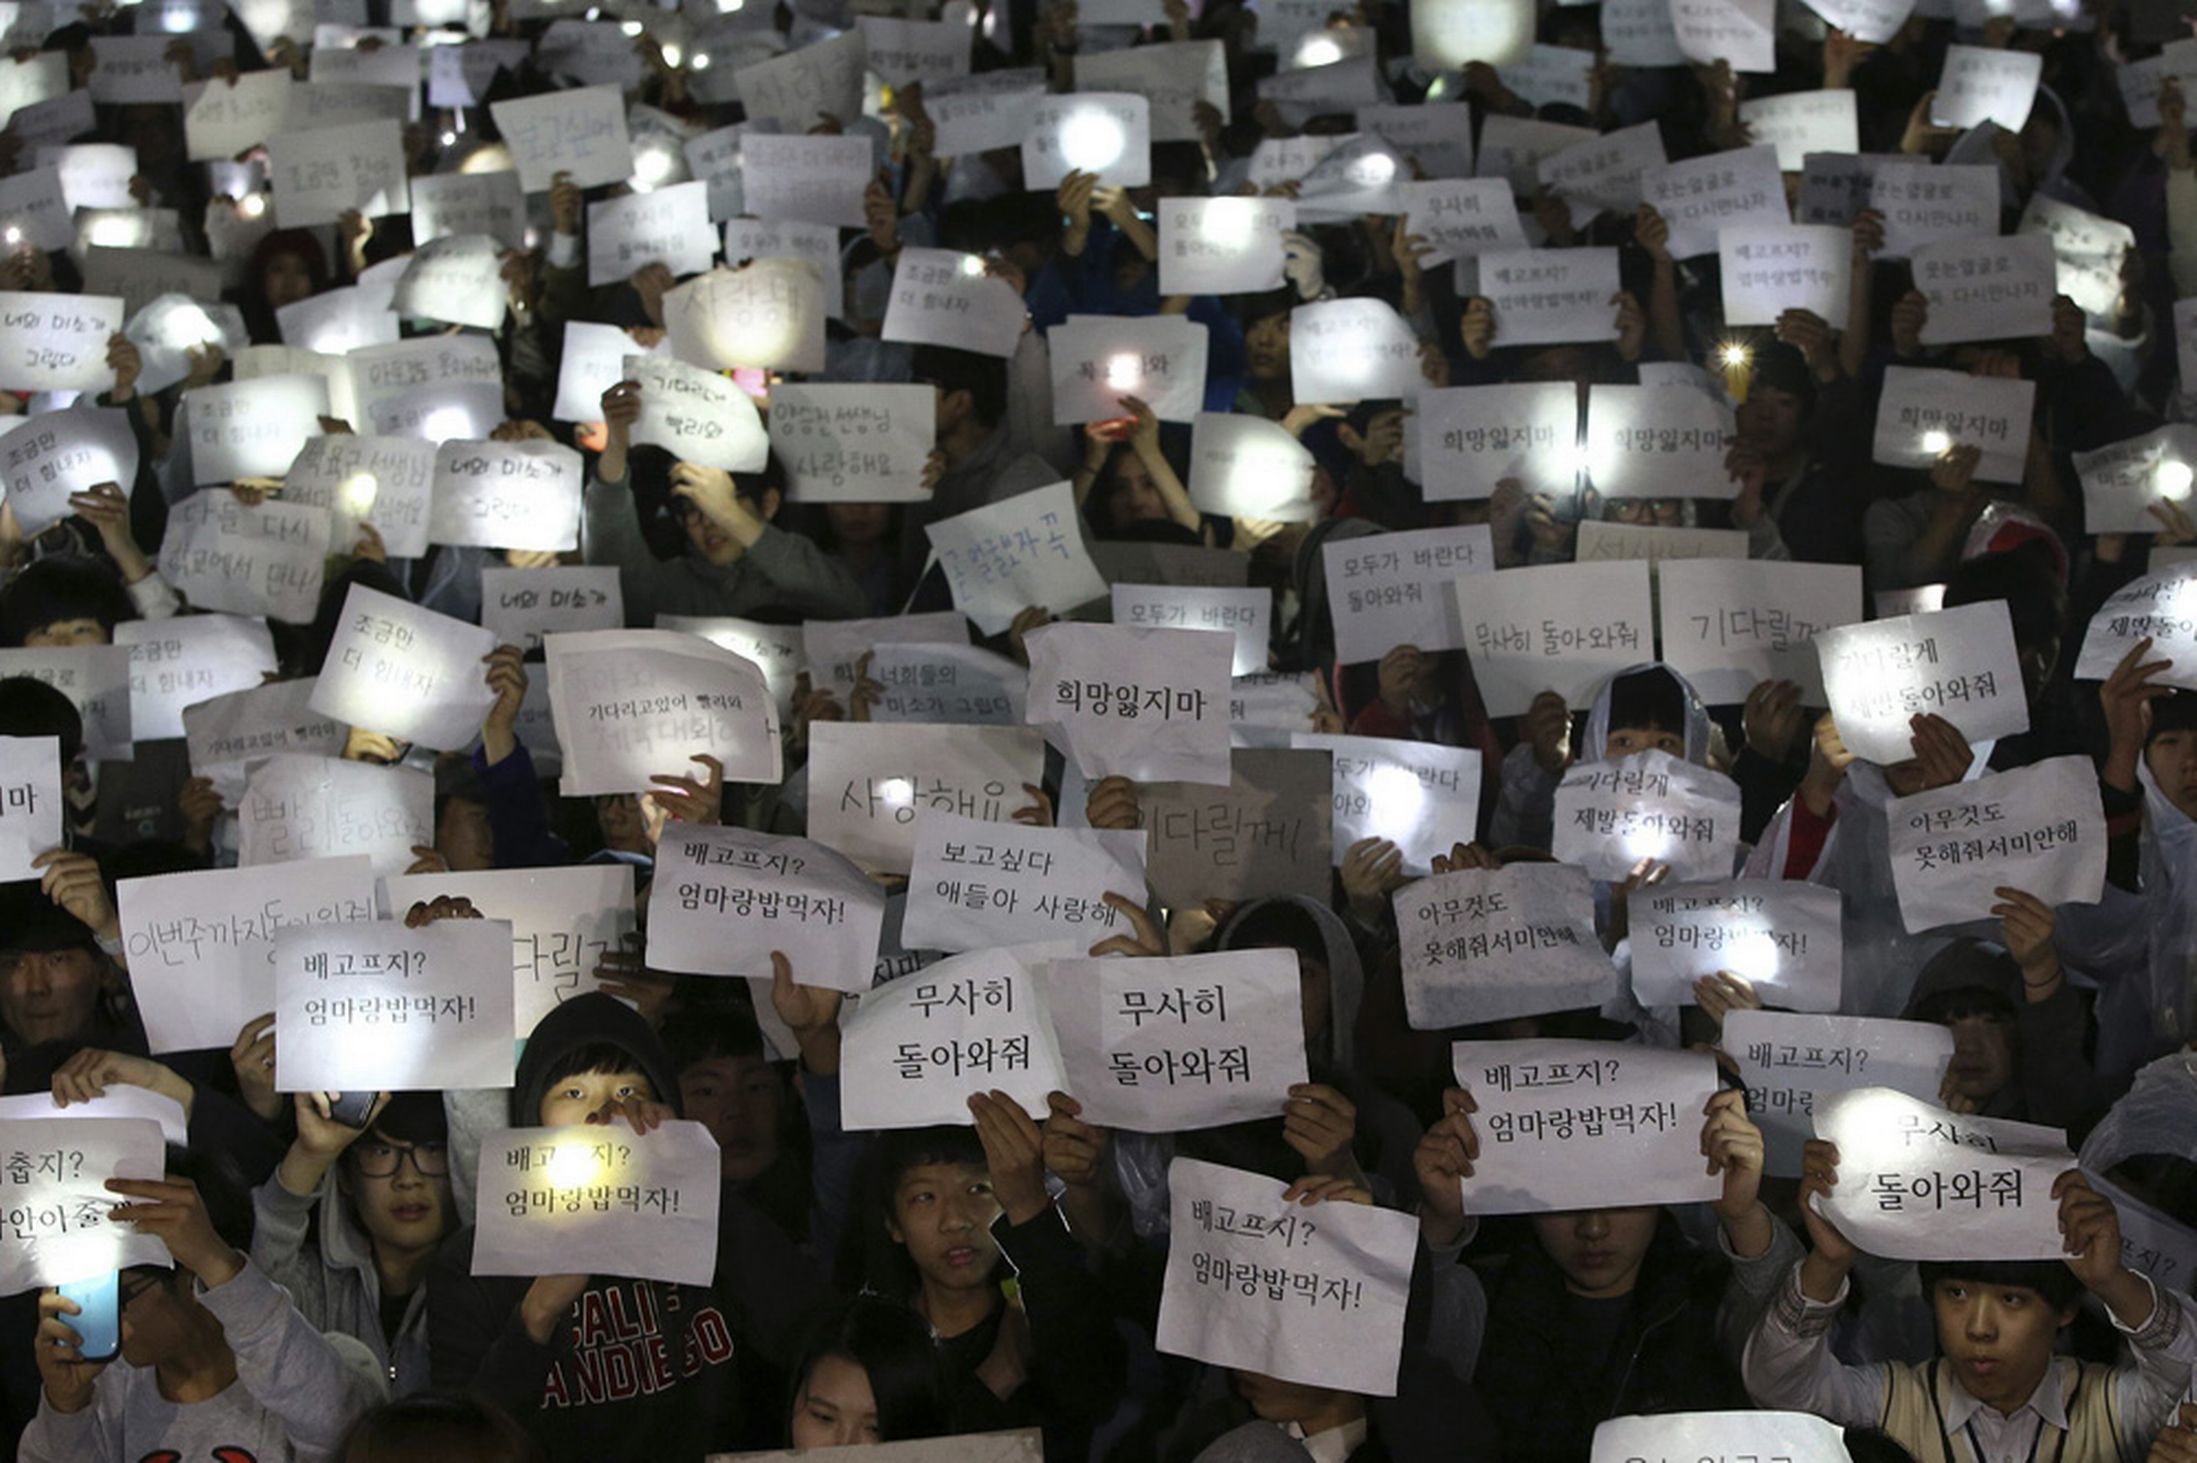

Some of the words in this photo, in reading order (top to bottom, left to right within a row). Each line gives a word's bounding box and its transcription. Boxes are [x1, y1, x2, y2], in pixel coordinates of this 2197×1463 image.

[1055, 679, 1208, 721] 희망잃지마
[0, 783, 38, 816] 마
[1909, 801, 2007, 834] 아무것도
[684, 840, 806, 877] 배고프지?
[941, 841, 1055, 877] 보고싶다
[1914, 818, 2080, 872] 못해줘서미안해
[678, 882, 846, 925] 엄마랑밥먹자!
[936, 878, 1019, 914] 애들아
[1033, 894, 1118, 928] 사랑해
[1417, 892, 1509, 928] 아무것도
[1654, 924, 1809, 957] 엄마랑자!
[303, 950, 427, 980] 배고프지?
[303, 995, 477, 1026] 엄마랑밥먹자!
[909, 976, 1014, 1019] 무사히
[1118, 984, 1228, 1027] 무사히
[893, 1034, 1031, 1079] 돌아와줘
[1107, 1044, 1252, 1087] 돌아와줘
[1483, 1059, 1620, 1092] 배고프지?
[1748, 1042, 1870, 1074] 배고프지?
[1488, 1101, 1679, 1144] 엄마랑밥먹자!
[0, 1150, 85, 1188] 춥지?
[505, 1141, 632, 1173] 배고지?
[505, 1185, 680, 1216] 엄마랑밥먹자!
[1870, 1167, 2023, 1212] 돌아와줘
[1191, 1200, 1317, 1247] 배고프지?
[1191, 1251, 1363, 1312] 엄마랑밥먹자!
